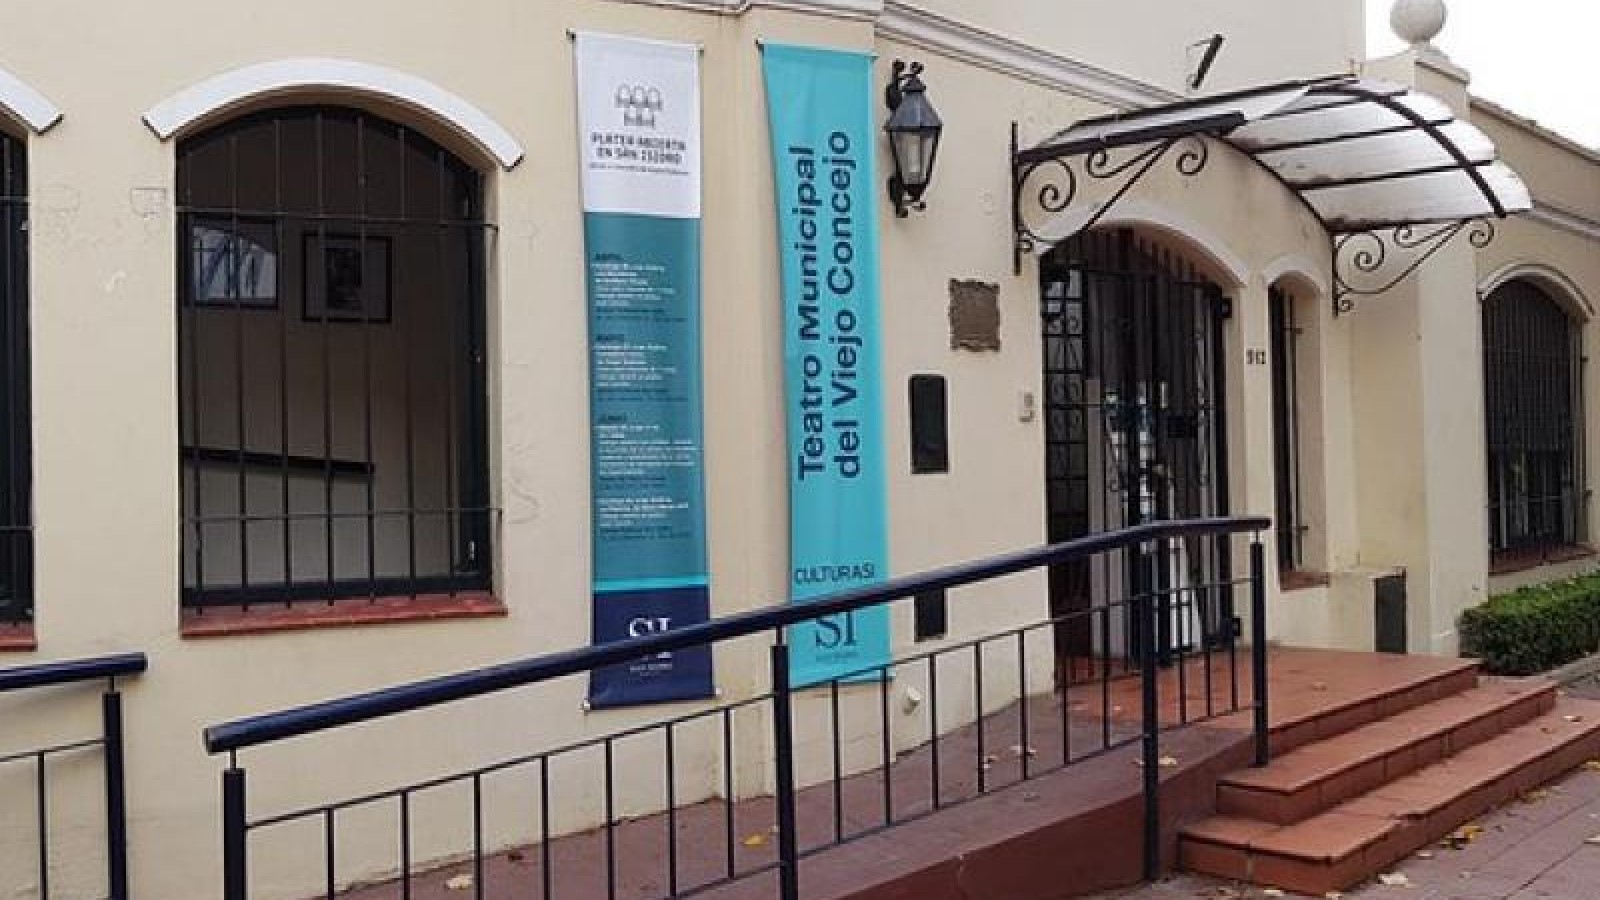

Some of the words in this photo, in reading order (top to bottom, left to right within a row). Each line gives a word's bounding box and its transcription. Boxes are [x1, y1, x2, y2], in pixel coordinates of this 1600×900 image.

[788, 146, 823, 341] Municipal
[822, 131, 857, 295] Concejo
[798, 354, 825, 481] Teatro
[828, 309, 863, 408] Viejo
[832, 419, 861, 478] del
